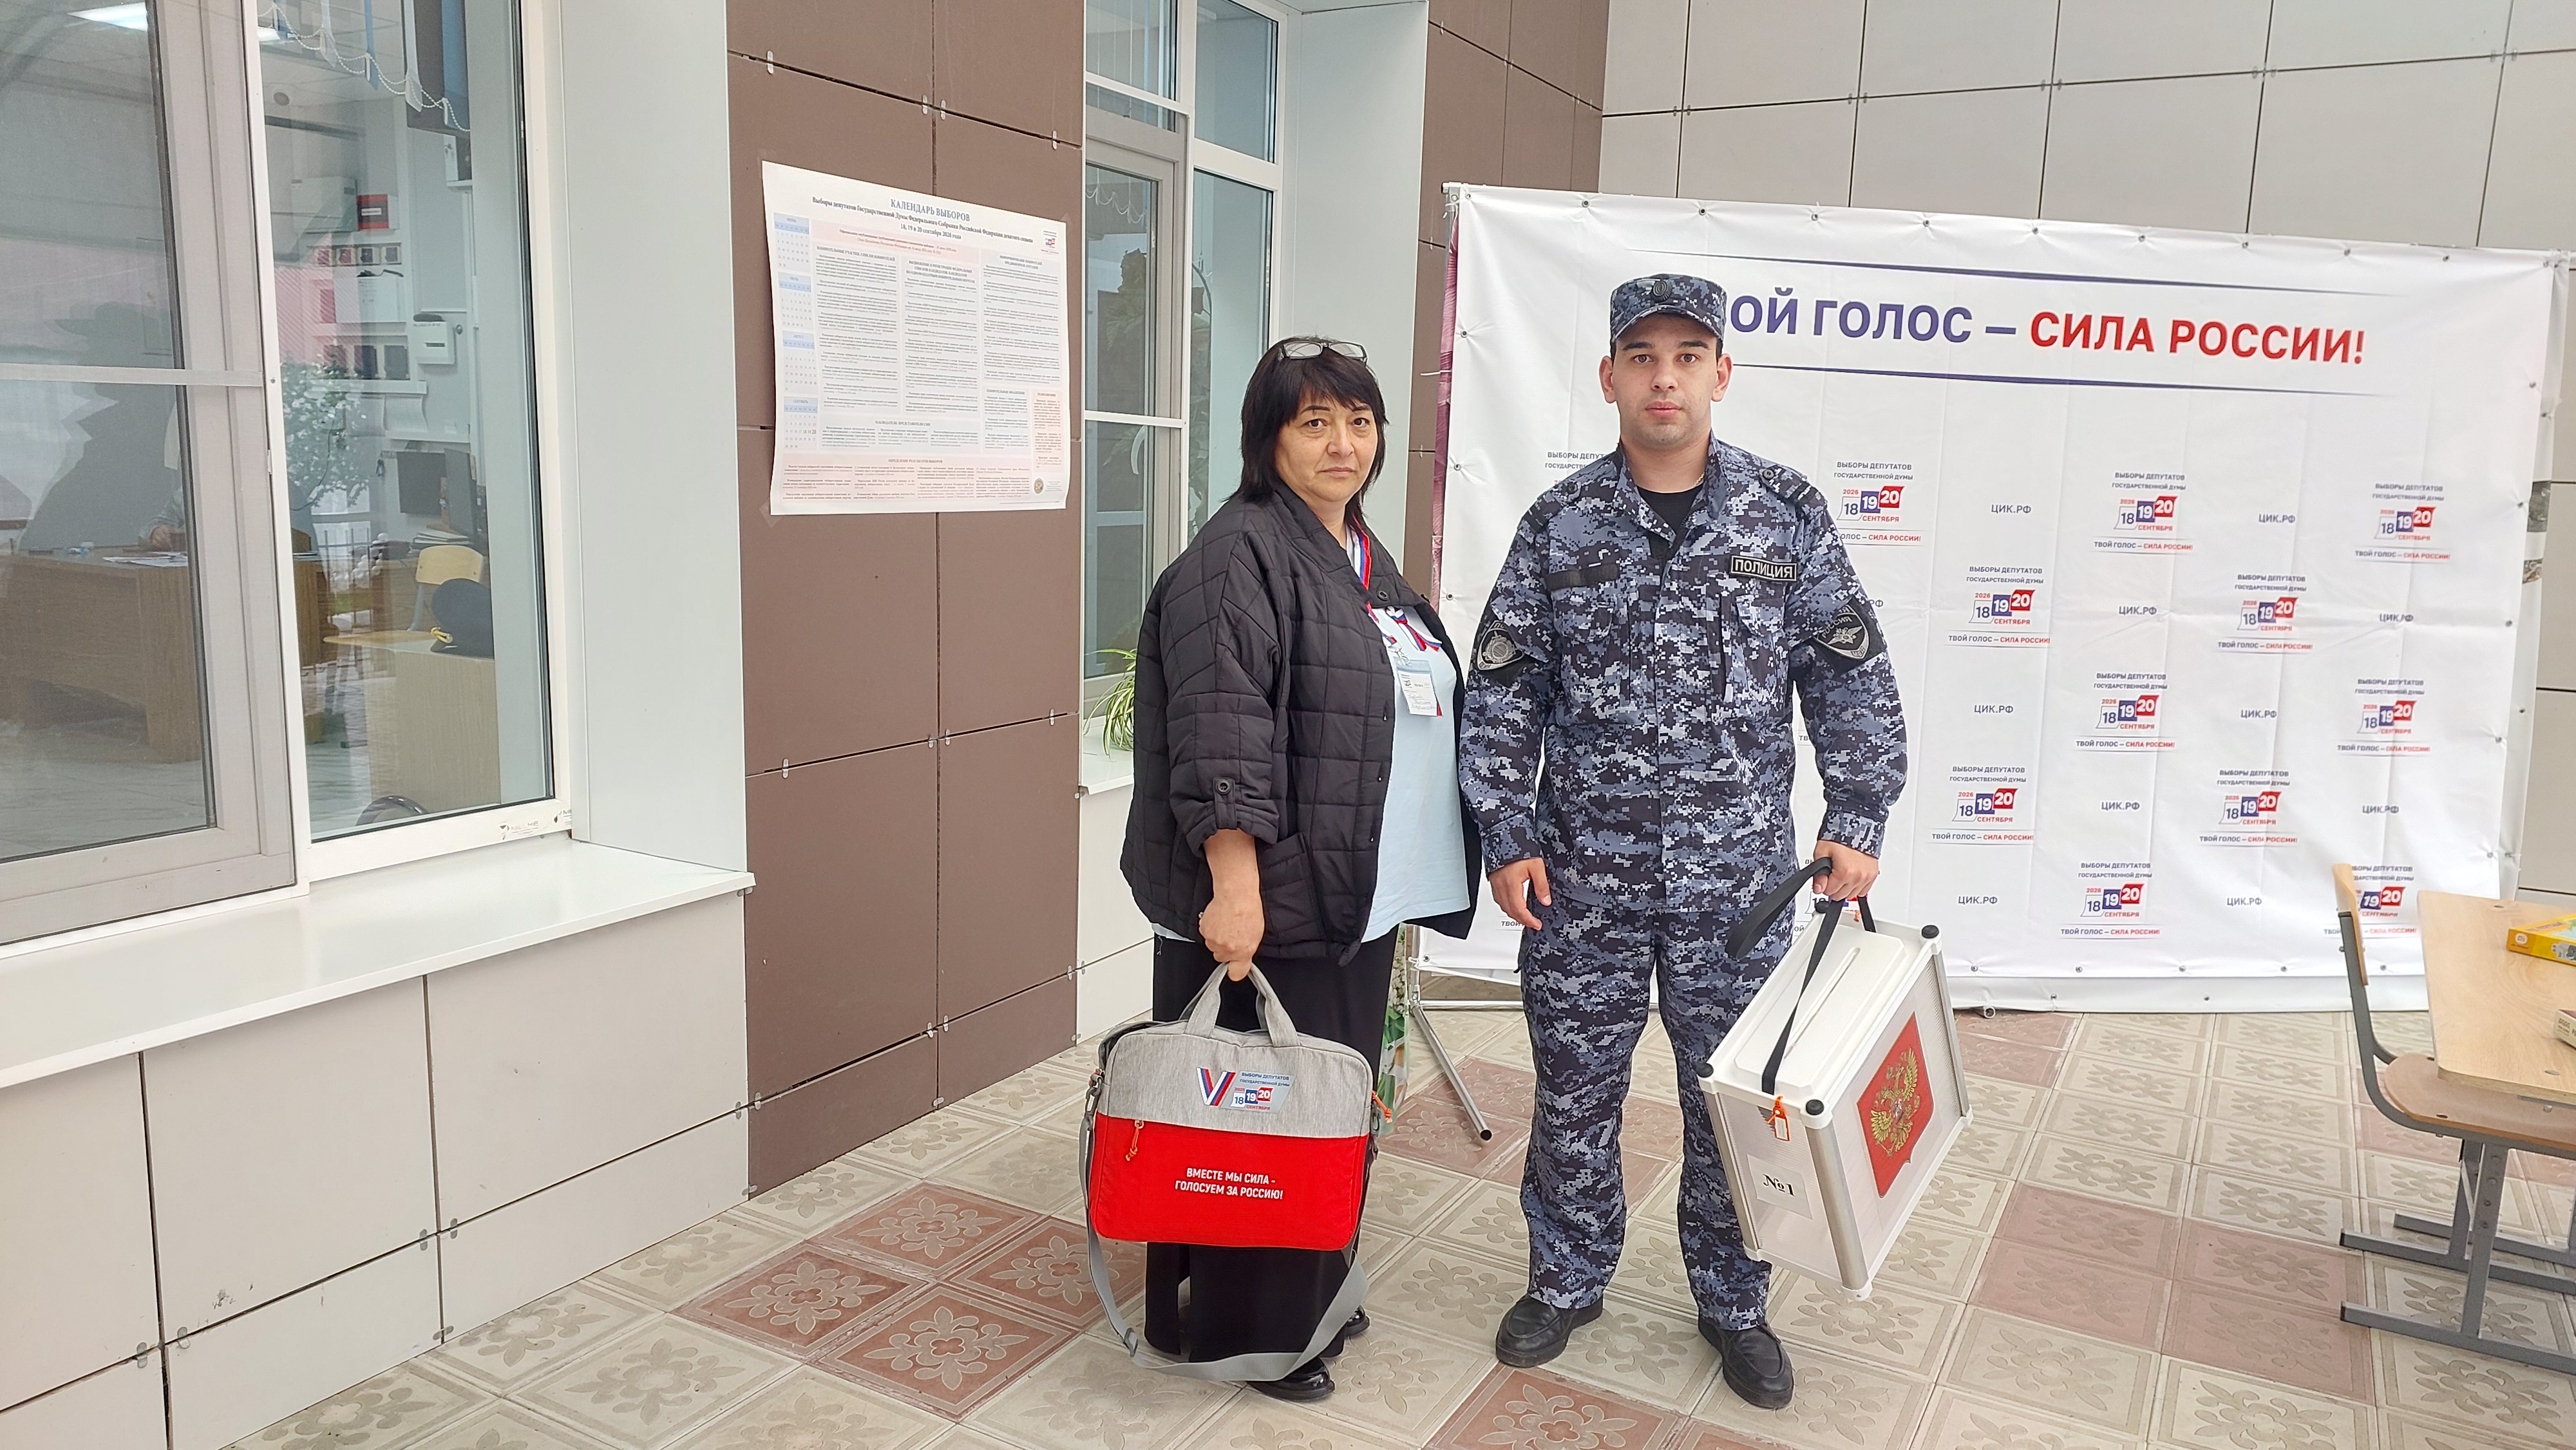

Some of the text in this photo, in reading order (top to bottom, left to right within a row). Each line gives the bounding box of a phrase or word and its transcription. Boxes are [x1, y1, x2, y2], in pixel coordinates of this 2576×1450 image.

[812, 196, 832, 207] Выборы
[891, 199, 970, 221] КАЛЕНДАРЬ ВЫБОРОВ
[1730, 287, 2365, 364] ОЙ ГОЛОС СИЛА РОССИИ!
[1844, 491, 1899, 515] 18 19 20
[1991, 504, 2031, 514] ЦИК.РФ
[2121, 500, 2173, 524] 18 19 20
[2259, 514, 2295, 523] ЦИК.РФ
[2382, 511, 2430, 533] 18 19 20
[1735, 559, 1793, 579] ПОЛИЦИЯ
[1976, 594, 2030, 618] 18 19 20
[2119, 605, 2157, 616] ЦИК.РФ
[2243, 601, 2293, 625] 18 19 20
[1822, 616, 1853, 638] РОССИЯ
[1975, 705, 2013, 714] ЦИК.РФ
[2103, 699, 2154, 723] 18 19 20
[2240, 709, 2277, 719] ЦИК.РФ
[2365, 717, 2378, 728] 18
[2394, 704, 2411, 717] 20
[1960, 793, 2012, 816] 18 19 20
[2101, 802, 2140, 811] ЦИК.РФ
[1958, 896, 1998, 905] ЦИК.РФ
[2088, 888, 2139, 912] 18 19 20
[2227, 898, 2262, 907] ЦИК.РФ
[2364, 890, 2401, 907] 19 20
[1247, 1093, 1256, 1101] 19
[1258, 1090, 1270, 1098] 20
[1187, 1168, 1269, 1184] ВМЕСТЕ МЫ СИЛА
[1175, 1180, 1283, 1200] ГОЛОСУЕМ ЗА РОССИЮ!
